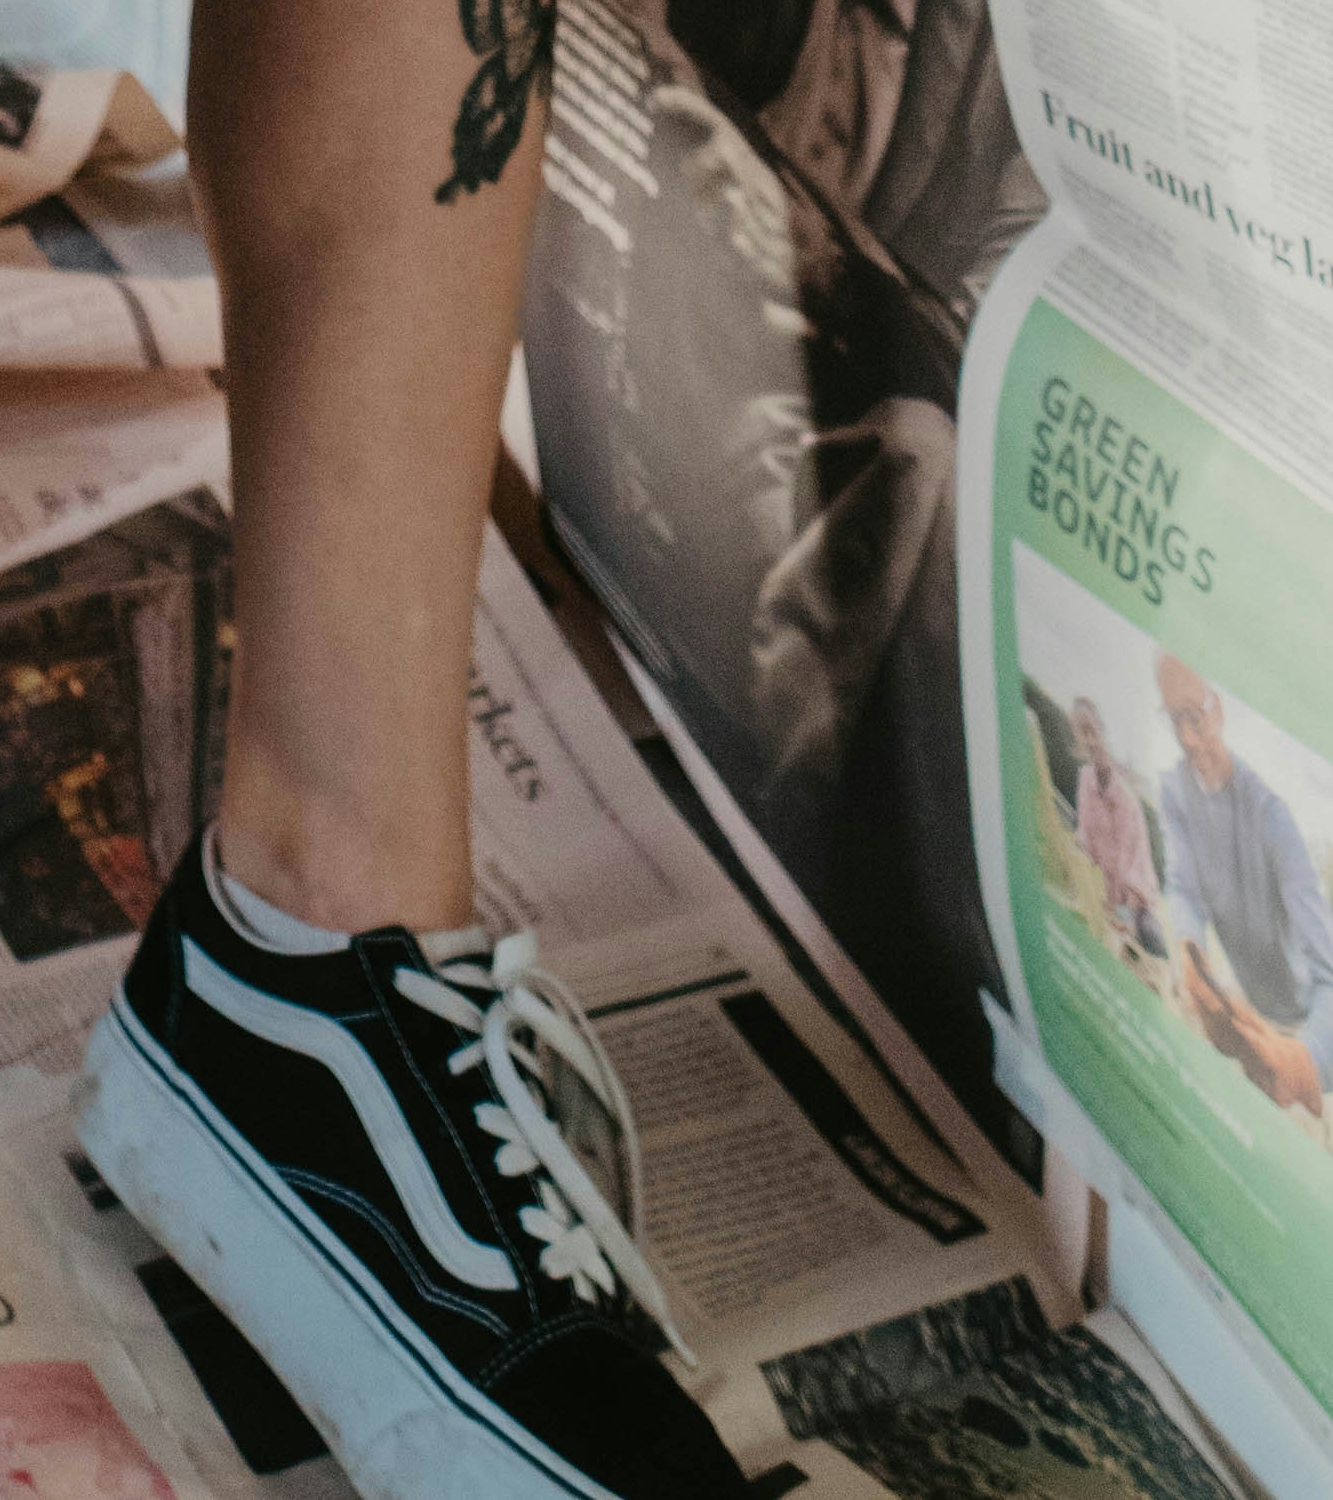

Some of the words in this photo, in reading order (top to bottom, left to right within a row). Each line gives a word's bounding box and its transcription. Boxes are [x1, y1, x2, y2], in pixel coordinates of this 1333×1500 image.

[1039, 88, 1134, 174] Fruit
[1144, 156, 1220, 223] and
[1034, 421, 1217, 594] SAVINGS
[1041, 375, 1181, 511] GREEN
[1027, 465, 1165, 606] BONDS
